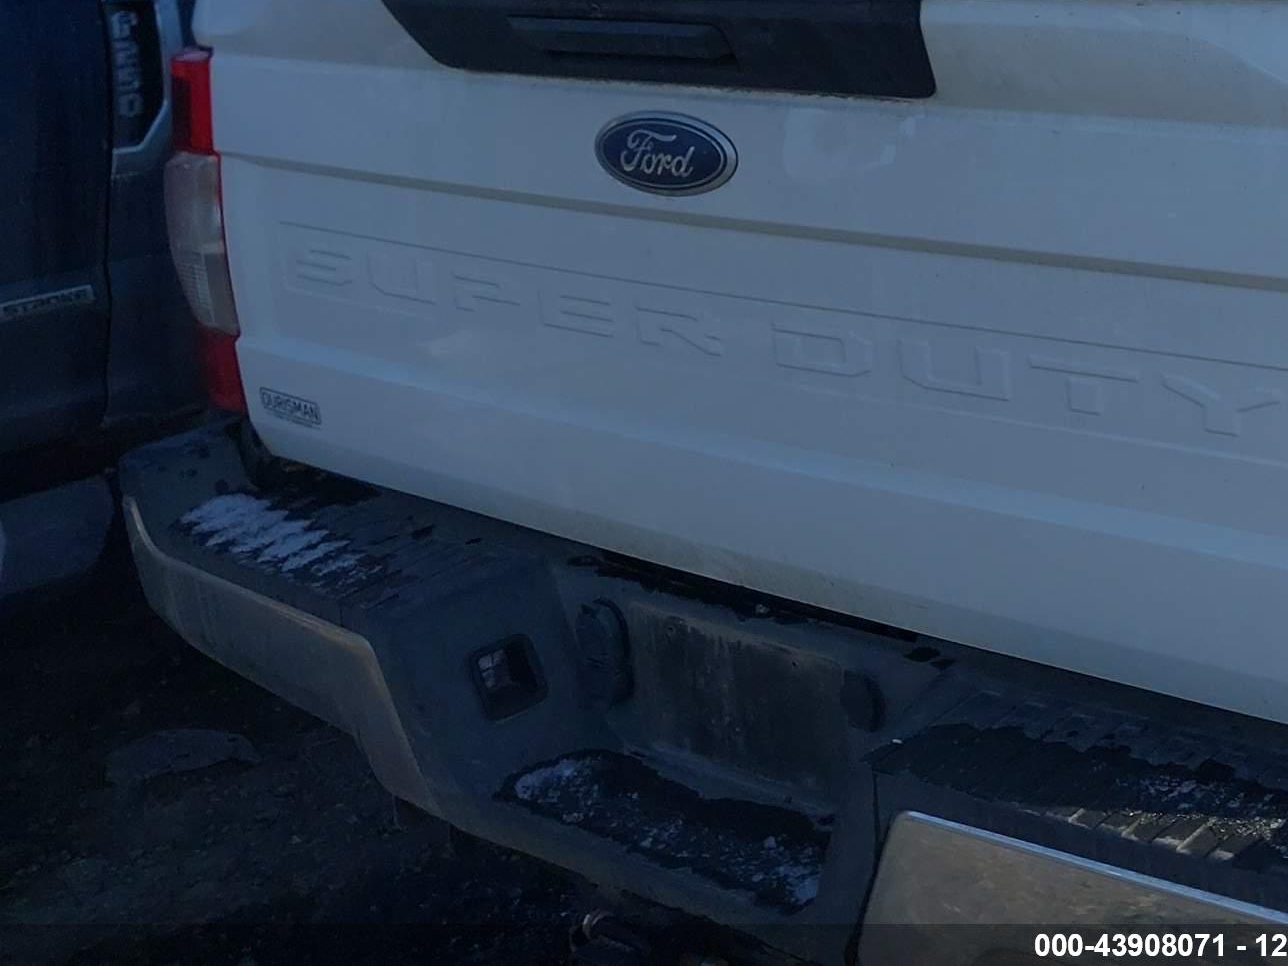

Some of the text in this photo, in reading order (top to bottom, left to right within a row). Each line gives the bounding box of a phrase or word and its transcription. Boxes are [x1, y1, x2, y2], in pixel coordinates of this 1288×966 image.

[620, 129, 695, 178] Ford
[296, 246, 1283, 437] SUPER DUTY
